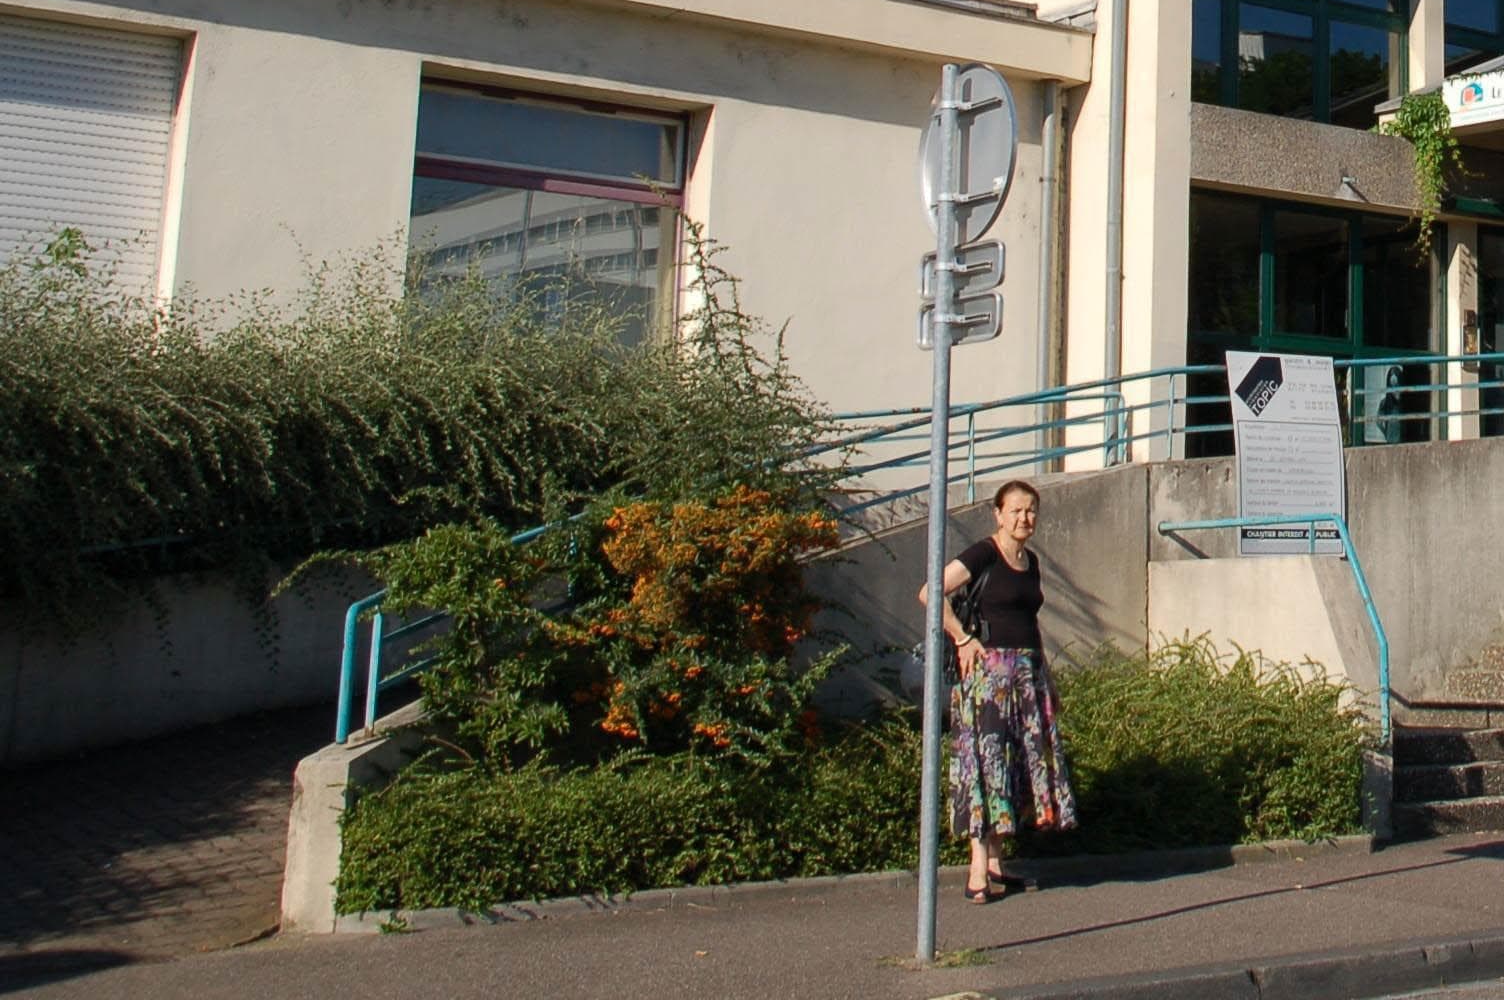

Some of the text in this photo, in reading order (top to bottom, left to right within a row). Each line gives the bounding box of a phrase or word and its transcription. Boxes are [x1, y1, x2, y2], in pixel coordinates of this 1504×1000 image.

[1251, 380, 1279, 414] TOPIC
[1246, 530, 1276, 538] CHANTIER
[1315, 530, 1337, 538] PUBLIC
